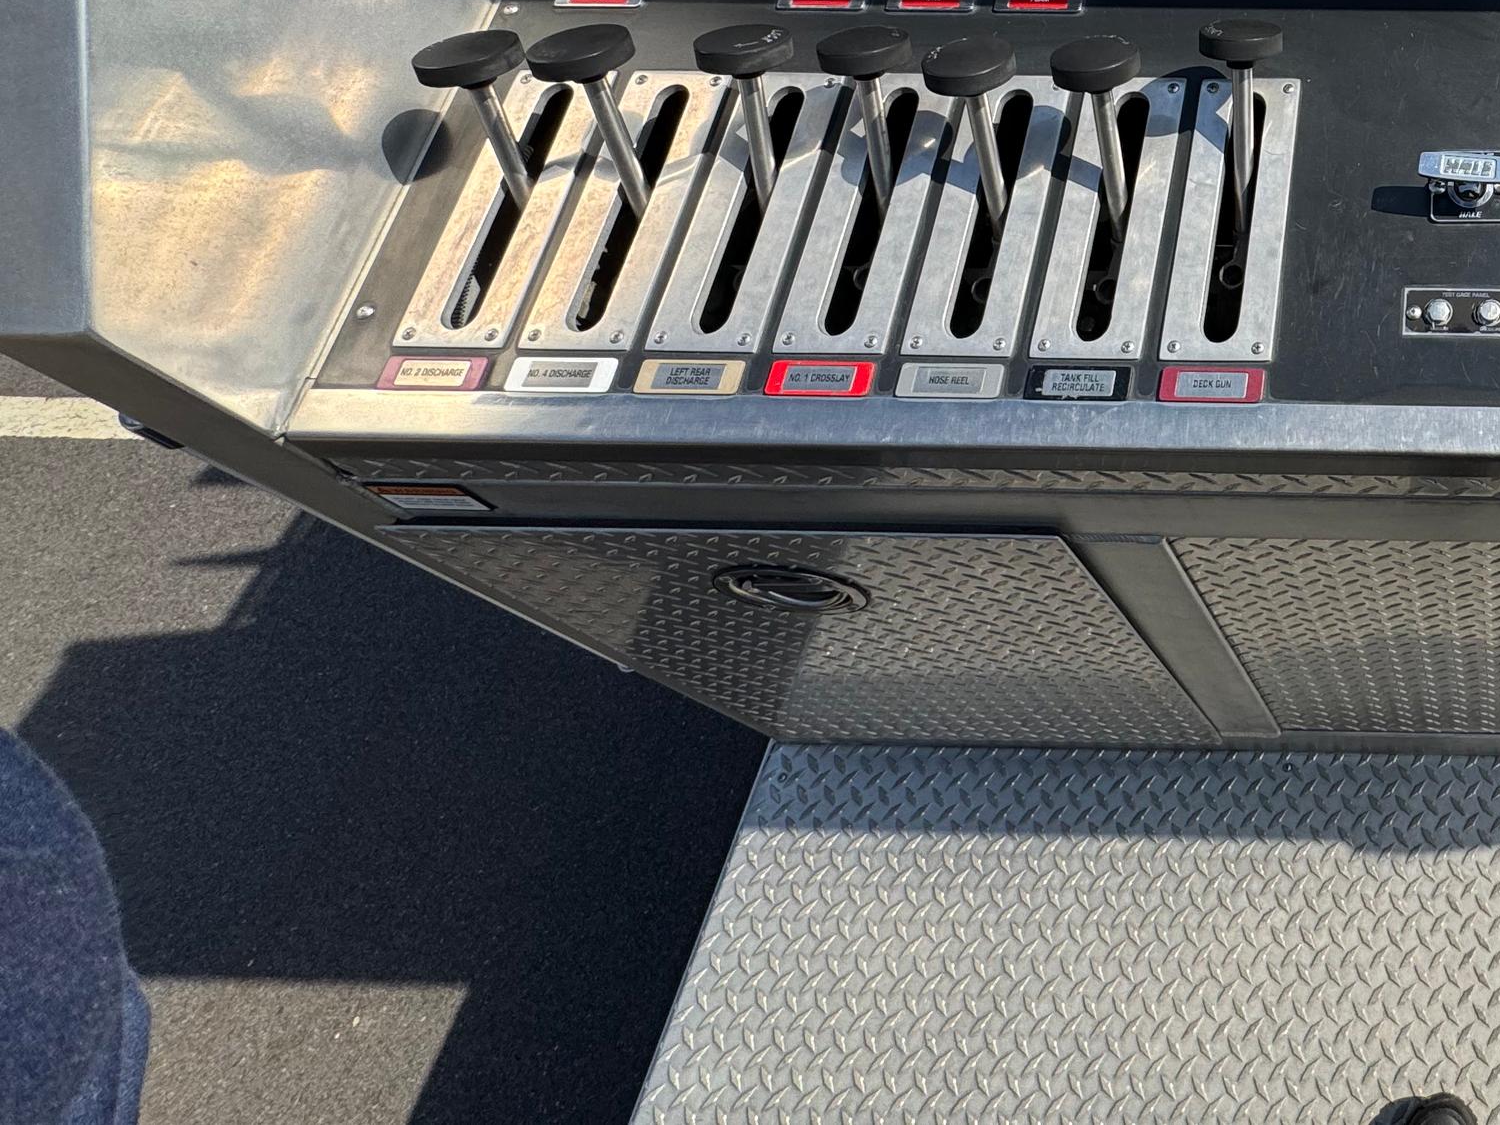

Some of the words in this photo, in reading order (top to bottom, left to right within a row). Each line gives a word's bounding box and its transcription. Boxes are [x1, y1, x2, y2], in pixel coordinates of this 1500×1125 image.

[401, 367, 412, 377] NO.
[414, 367, 420, 377] 2
[421, 367, 464, 377] DISCHARGE
[528, 369, 540, 378] NO.
[542, 369, 548, 378] 4
[549, 369, 593, 378] DISCHARGE
[670, 368, 688, 376] LEFT
[690, 368, 711, 376] REAR
[666, 376, 710, 385] DISCHARGE
[810, 373, 850, 382] CROSSLAY
[928, 376, 948, 385] HOSE
[950, 376, 969, 385] REEL
[1061, 373, 1082, 382] TANK
[1083, 373, 1099, 382] FILL
[1051, 382, 1104, 392] RECIRCULATE
[1193, 379, 1214, 388] DECK
[1215, 379, 1232, 388] GUN
